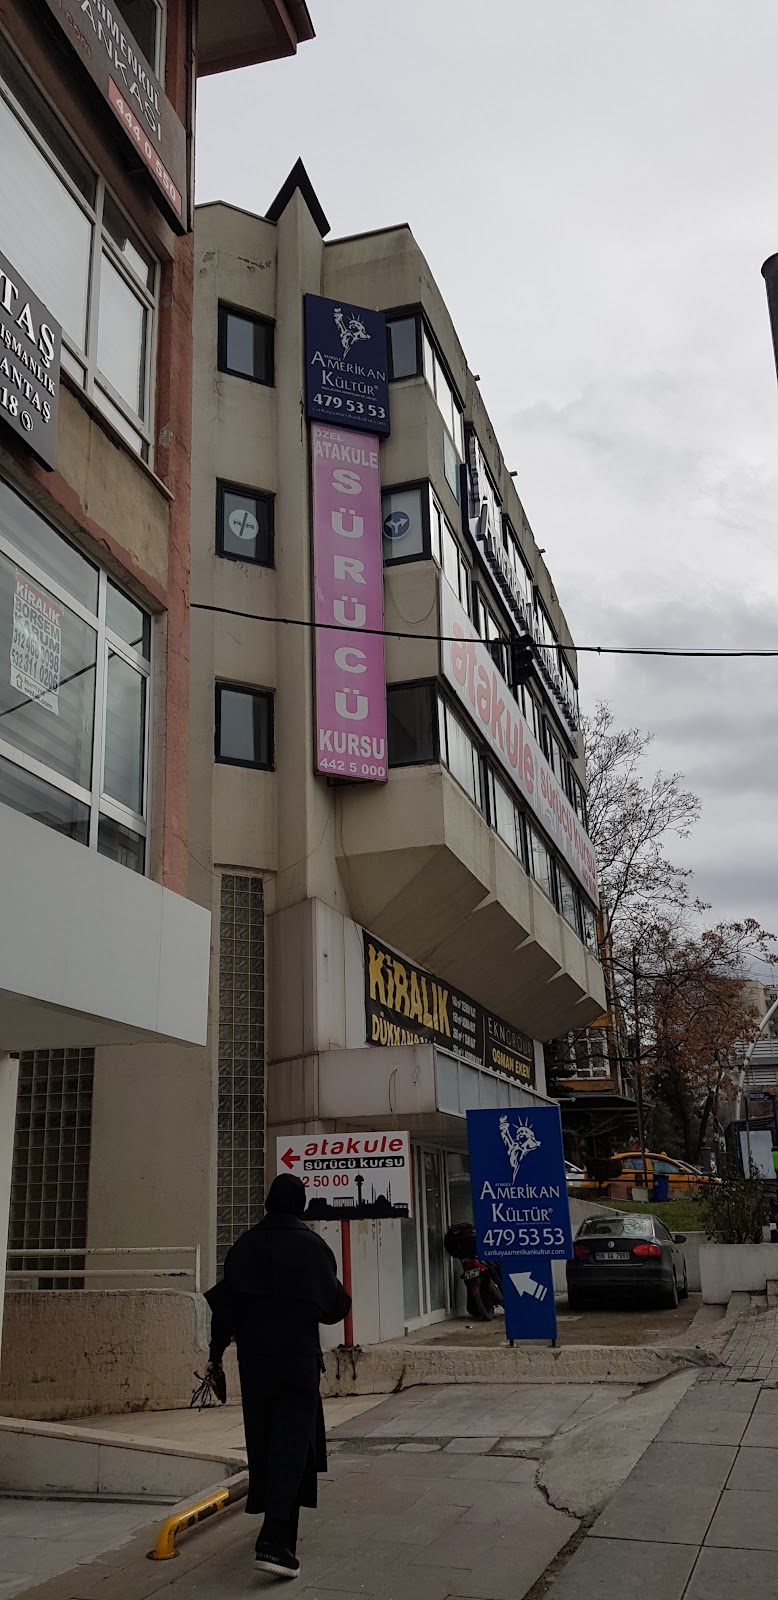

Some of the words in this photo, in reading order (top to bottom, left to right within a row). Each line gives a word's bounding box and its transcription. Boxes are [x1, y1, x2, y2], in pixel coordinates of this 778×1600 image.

[78, 0, 161, 142] ANKASI
[116, 98, 141, 142] 444
[143, 140, 153, 160] 0
[311, 350, 386, 383] AMERİKAN
[313, 393, 343, 409] 479
[346, 400, 364, 414] 53
[368, 404, 386, 419] 53
[315, 429, 344, 442] ÖZEL
[313, 439, 378, 470] ATAKULE
[16, 580, 61, 627] KİRALIK
[15, 597, 60, 643] BORSEM
[450, 621, 535, 796] atakule
[319, 728, 386, 764] KURSU
[319, 757, 345, 772] 442
[348, 761, 357, 774] 5
[360, 763, 386, 778] 000
[368, 943, 451, 1038] KİRALIK
[492, 1047, 515, 1072] OSMAN
[304, 1136, 404, 1157] atakule
[305, 1158, 357, 1171] sürücü
[360, 1157, 404, 1169] kursu
[313, 1175, 330, 1188] 50
[332, 1174, 349, 1187] 00
[480, 1180, 560, 1201] AMERİKAN
[483, 1229, 515, 1247] 479
[519, 1229, 541, 1247] 53
[542, 1228, 565, 1246] 53
